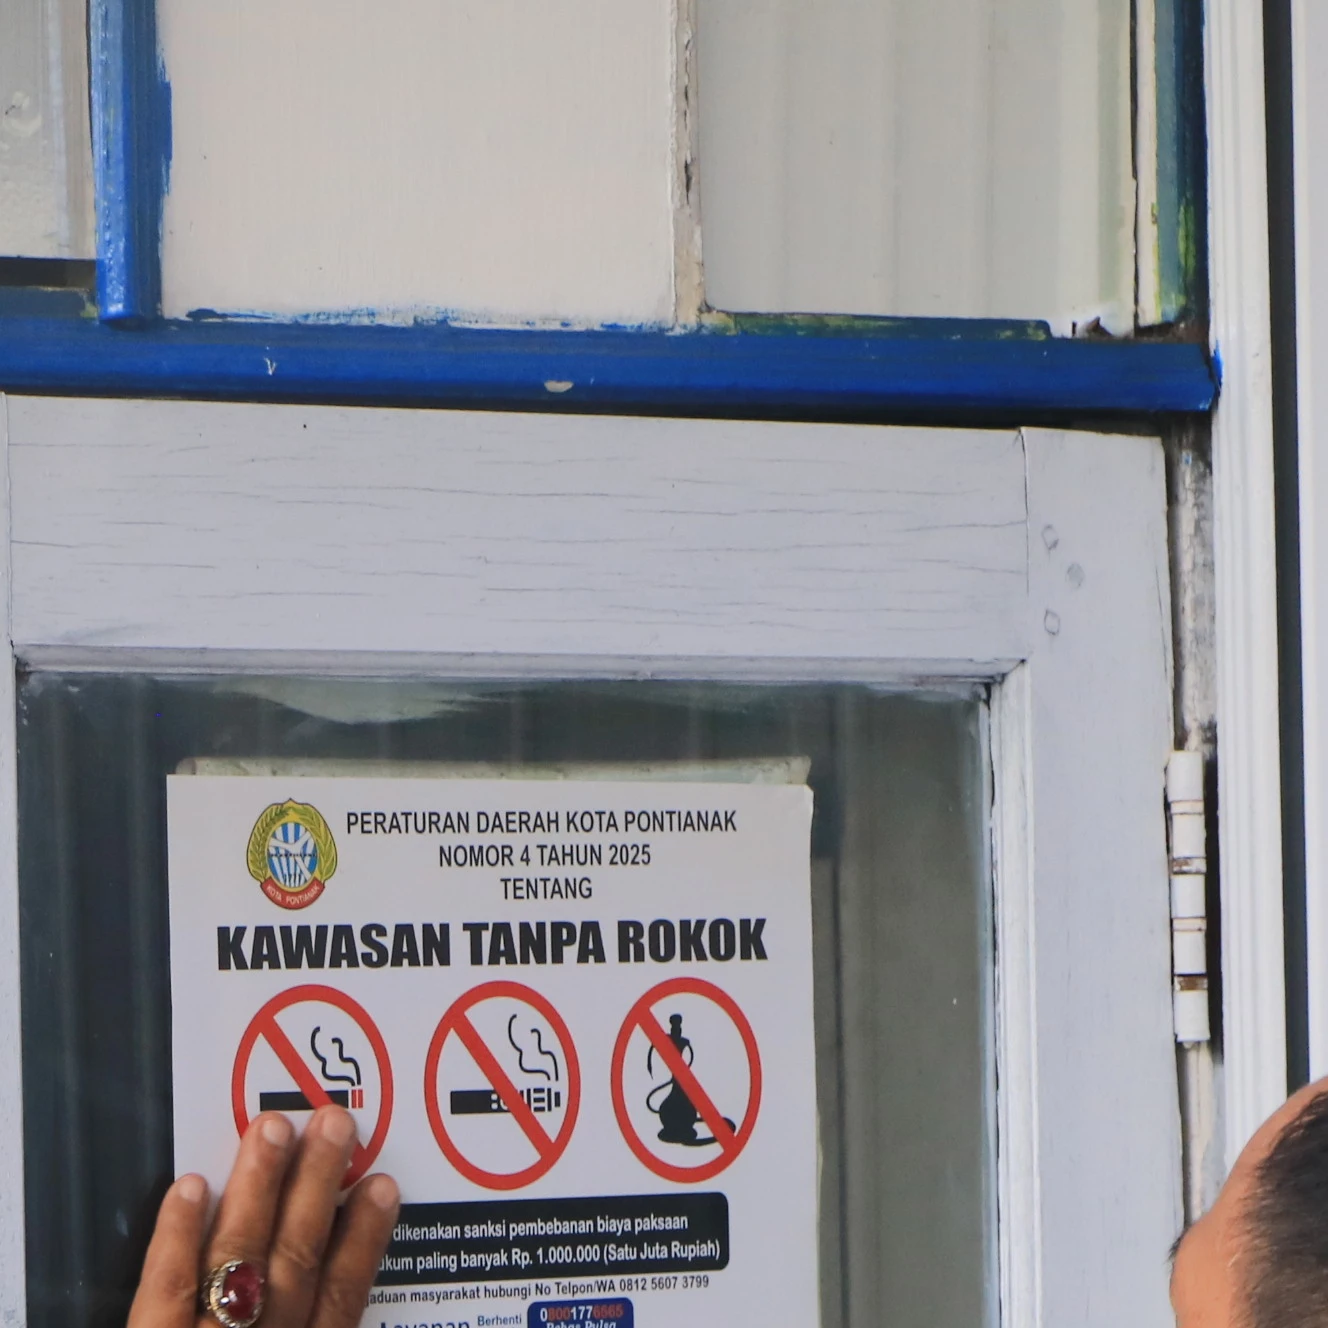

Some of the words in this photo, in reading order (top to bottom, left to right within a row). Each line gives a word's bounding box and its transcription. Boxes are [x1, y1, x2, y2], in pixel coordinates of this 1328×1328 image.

[347, 811, 470, 834] PERATURAN
[476, 810, 559, 834] DAERAH
[566, 810, 619, 833] KOTA
[624, 809, 738, 833] PONTIANAK
[439, 844, 514, 867] NOMOR
[520, 844, 531, 866] 4
[536, 844, 602, 866] TAHUN
[608, 843, 651, 866] 2025
[500, 877, 593, 900] TENTANG
[217, 923, 451, 971] KAWASAN
[462, 921, 606, 966] TANPA
[617, 918, 769, 963] ROKOK
[393, 1222, 461, 1241] dikenakan
[464, 1219, 506, 1238] sanksi
[509, 1217, 594, 1241] pembebanan
[597, 1214, 632, 1236] biaya
[634, 1212, 689, 1235] paksaan
[378, 1254, 413, 1271] ukum
[417, 1252, 457, 1274] paling
[460, 1249, 508, 1271] banyak
[511, 1247, 533, 1269] Rp.
[536, 1244, 601, 1265] 1.000.000
[603, 1243, 637, 1266] (Satu
[639, 1242, 668, 1261] Juta
[671, 1239, 721, 1261] Rupiah)
[368, 1290, 407, 1306] aduan
[410, 1285, 481, 1304] masyarakat
[484, 1283, 532, 1300] hubungi
[535, 1282, 551, 1296] No
[555, 1279, 616, 1297] Telpon/WA
[619, 1277, 647, 1293] 0812
[651, 1276, 679, 1290] 5607
[682, 1275, 710, 1289] 3799
[477, 1314, 522, 1328] Berhenti
